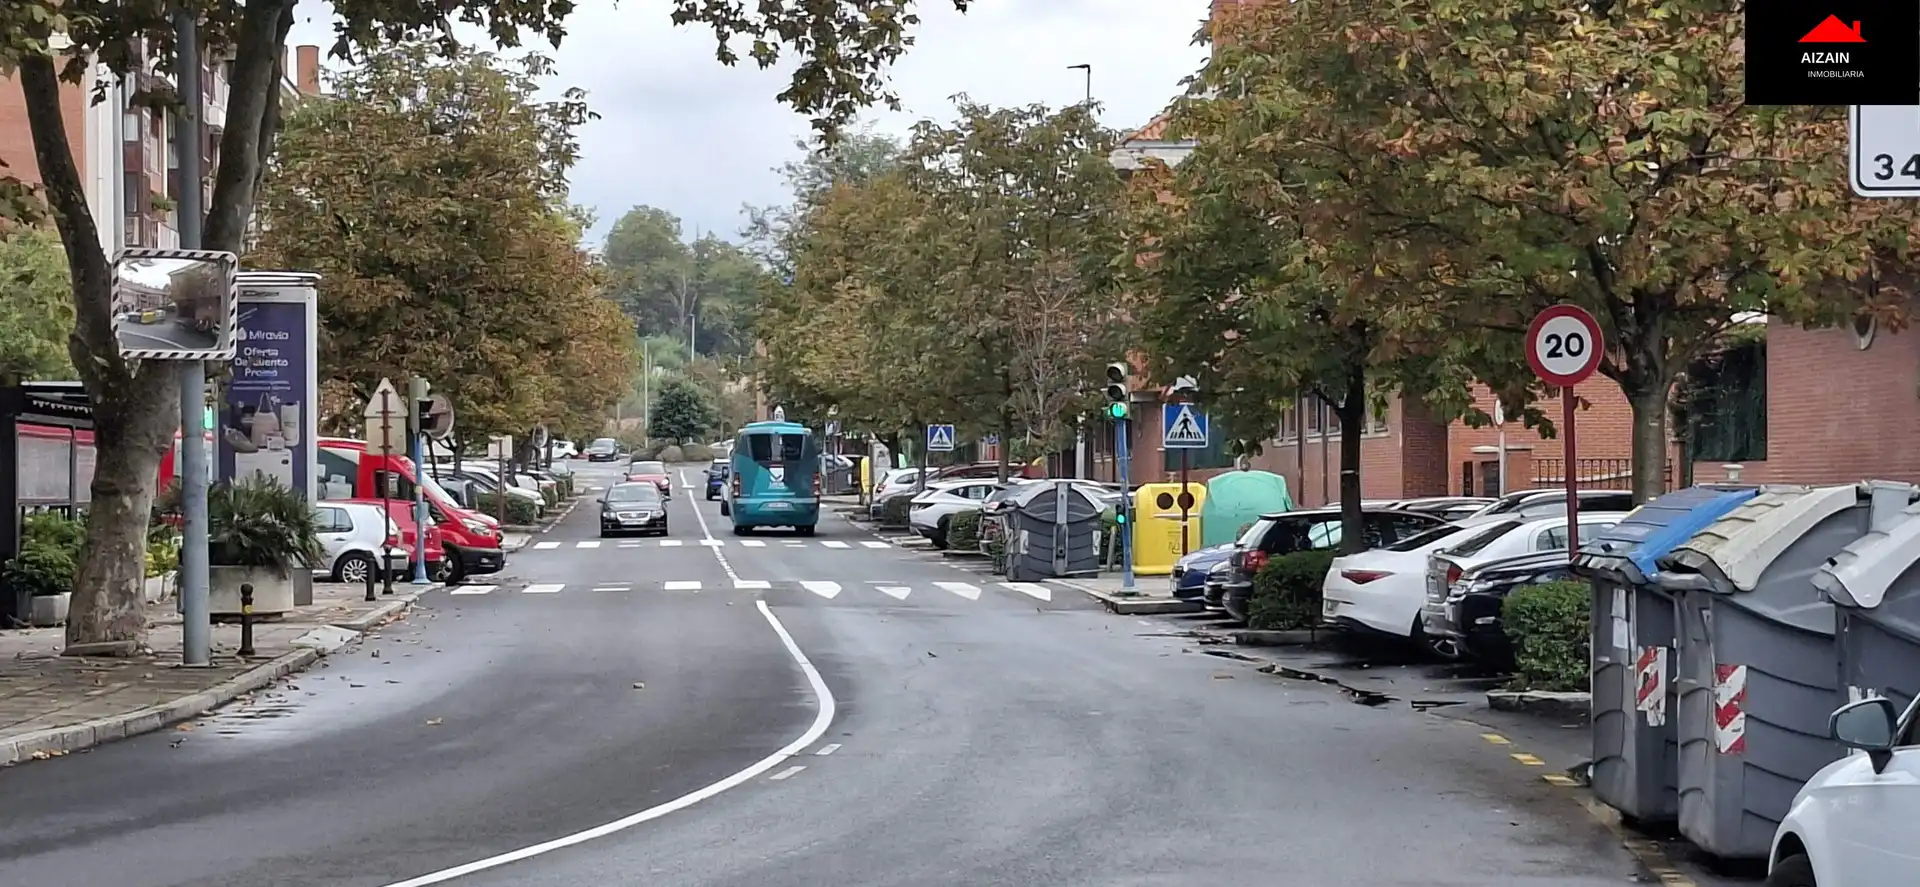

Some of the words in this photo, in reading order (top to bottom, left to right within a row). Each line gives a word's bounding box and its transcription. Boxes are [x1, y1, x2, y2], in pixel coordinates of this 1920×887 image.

[249, 331, 289, 340] Miravia
[1545, 332, 1584, 358] 20
[243, 347, 279, 357] Oferta
